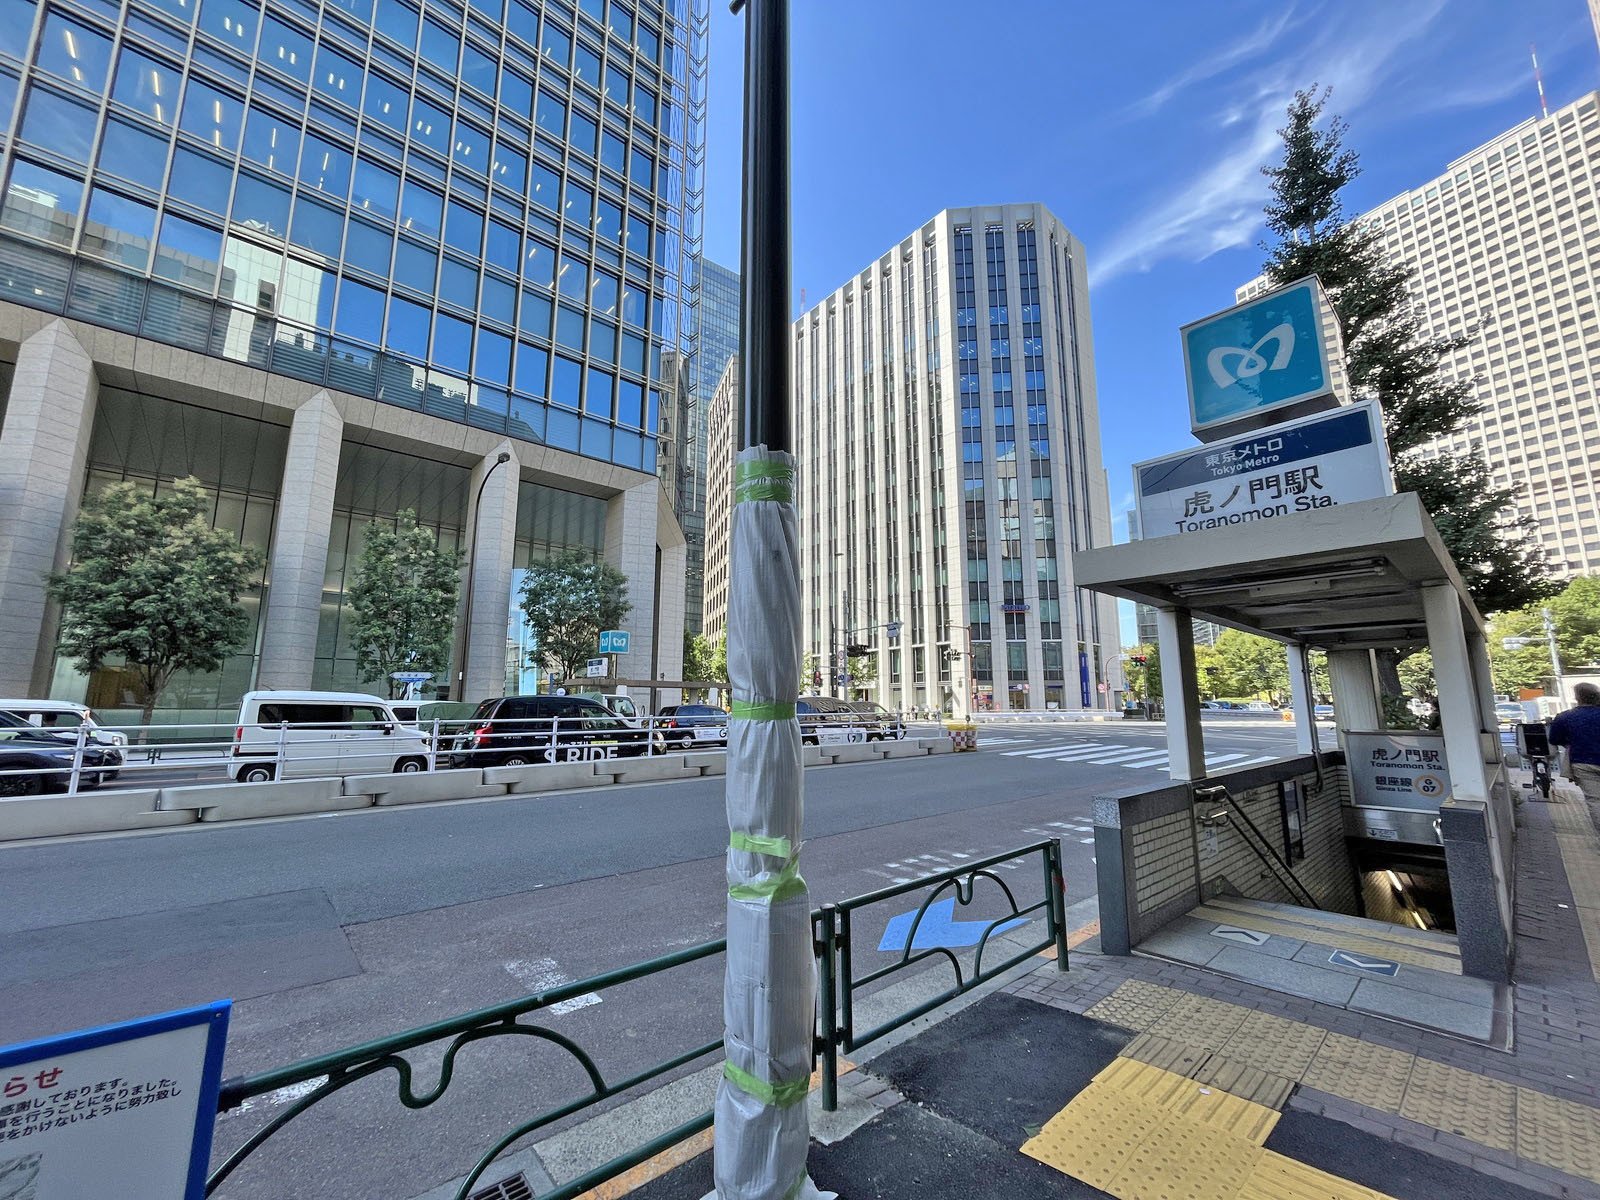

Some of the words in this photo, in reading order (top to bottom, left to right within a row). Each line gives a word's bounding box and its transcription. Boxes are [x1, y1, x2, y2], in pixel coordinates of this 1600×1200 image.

[1205, 437, 1283, 468] 東京メトロ
[1211, 464, 1243, 477] Tokyo
[1245, 454, 1280, 469] Metro
[1183, 465, 1324, 518] 虎ノ門駅
[1175, 503, 1288, 533] Toranomon
[1294, 494, 1338, 512] Sta.
[1370, 760, 1424, 770] Toranomon
[1427, 763, 1445, 771] Sta.
[1372, 748, 1440, 763] 虎ノ門駅
[3, 1067, 64, 1098] らせ
